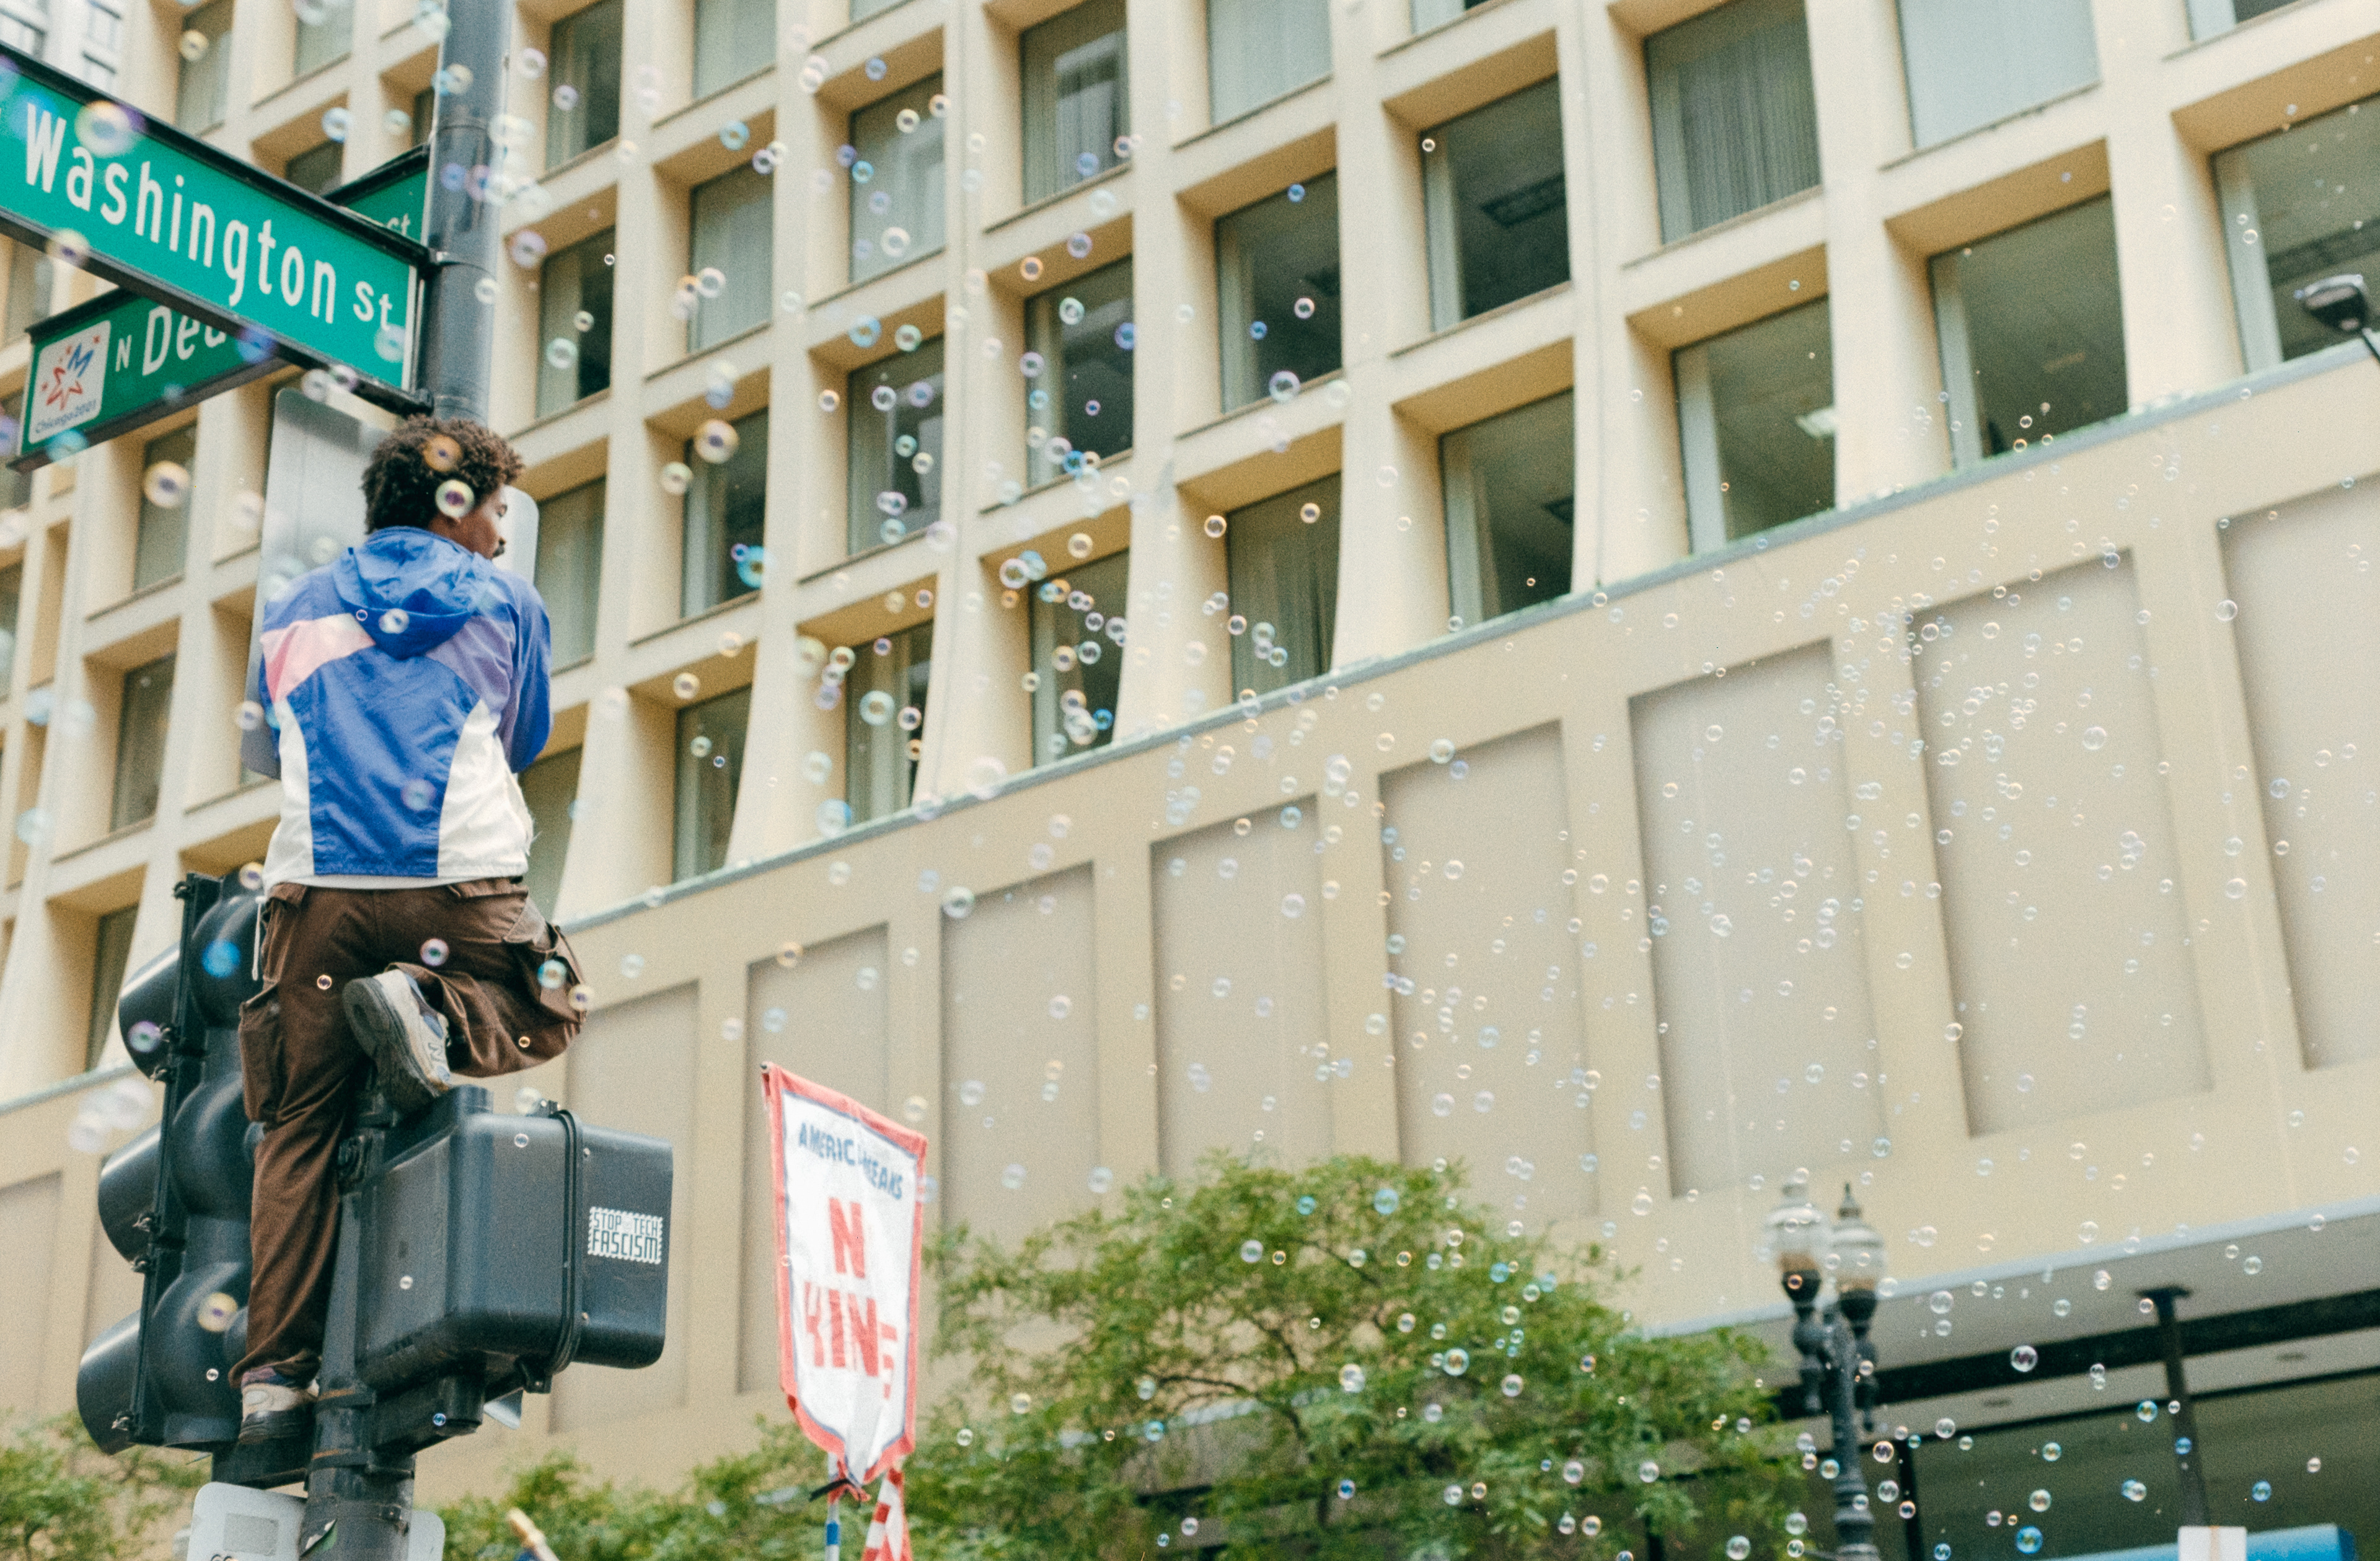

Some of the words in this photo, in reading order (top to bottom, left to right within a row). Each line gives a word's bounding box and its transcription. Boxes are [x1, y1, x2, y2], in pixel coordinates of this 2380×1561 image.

[25, 102, 337, 324] Washington
[353, 280, 393, 332] St
[115, 334, 132, 372] N
[593, 1211, 622, 1231] STOP
[633, 1217, 658, 1237] TECH
[593, 1229, 658, 1260] FASCISM
